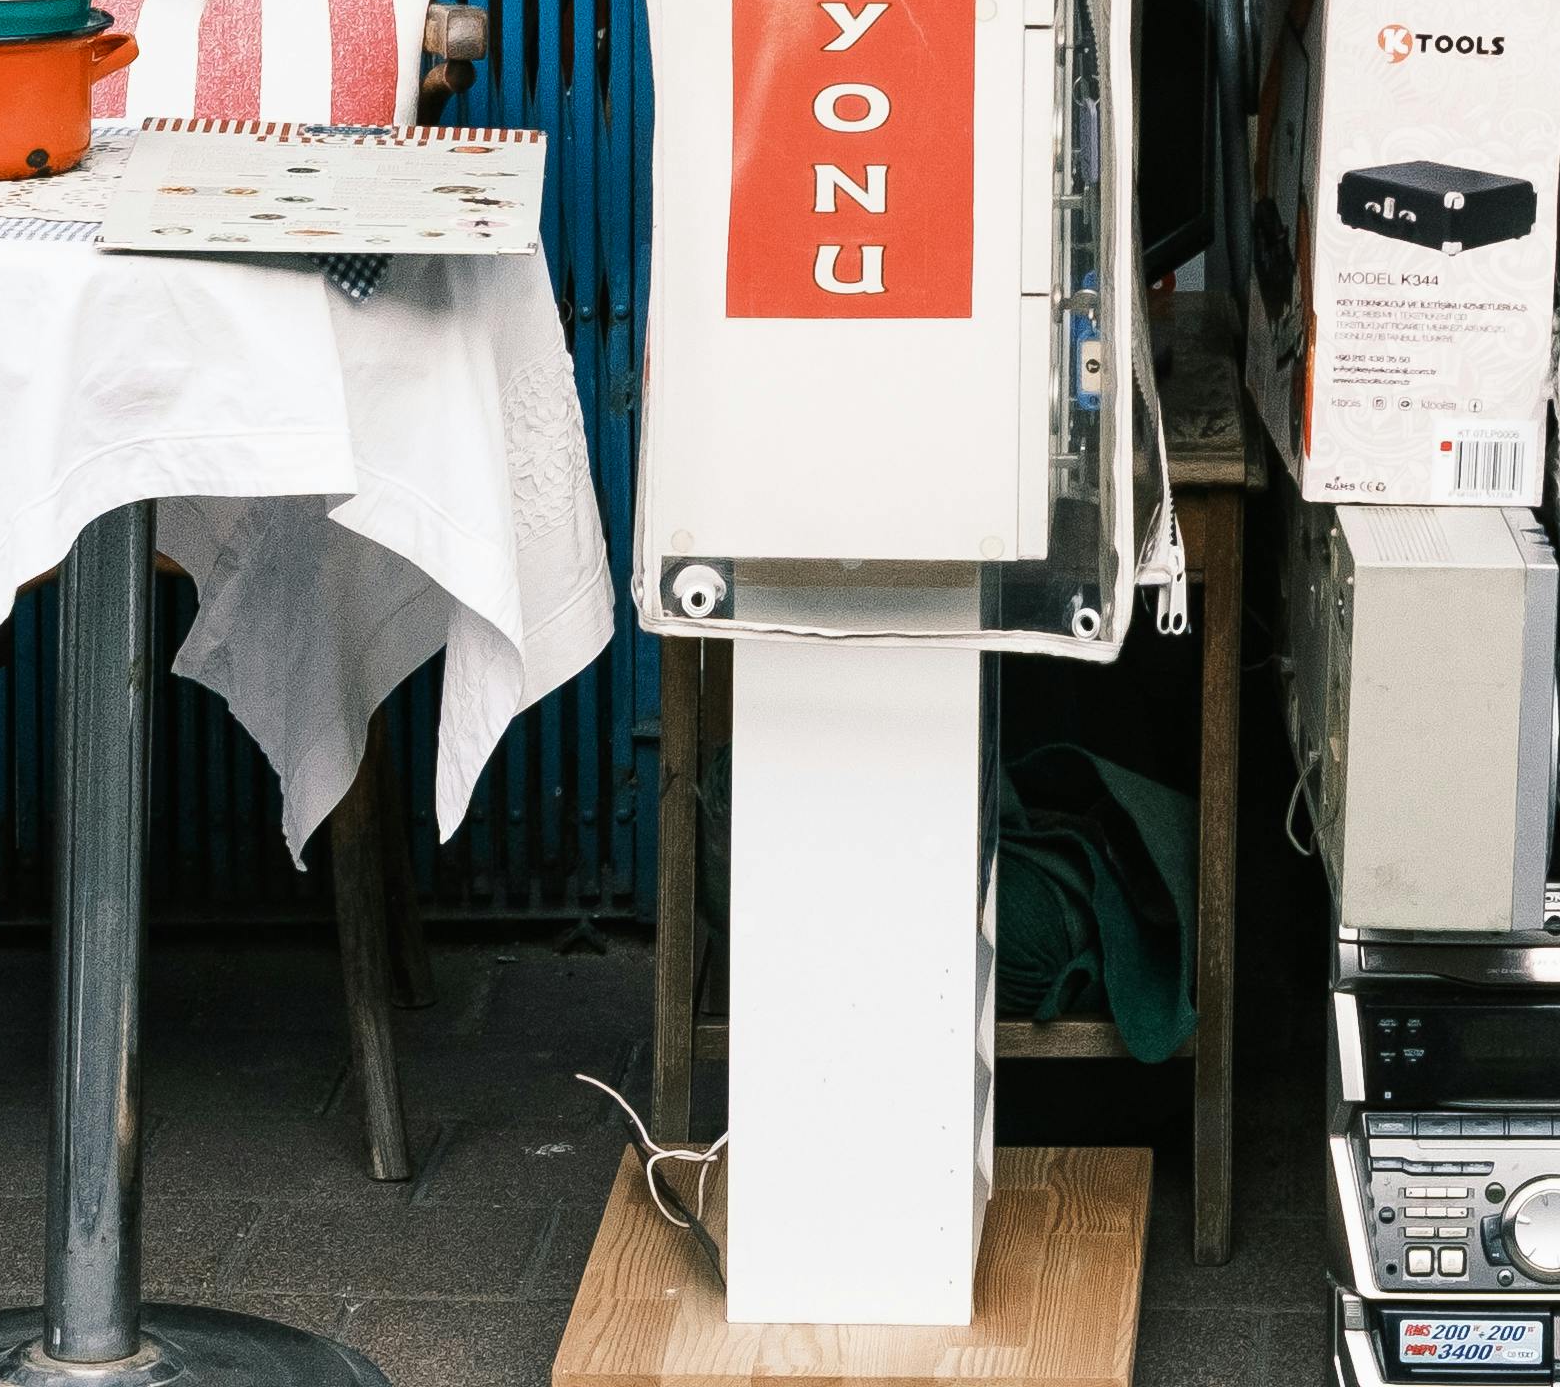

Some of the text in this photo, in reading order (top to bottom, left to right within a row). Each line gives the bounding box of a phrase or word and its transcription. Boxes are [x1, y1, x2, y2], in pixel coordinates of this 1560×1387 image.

[1337, 271, 1440, 287] MODEL K344
[1431, 1323, 1528, 1341] 200 200
[1437, 1343, 1493, 1361] 3400
